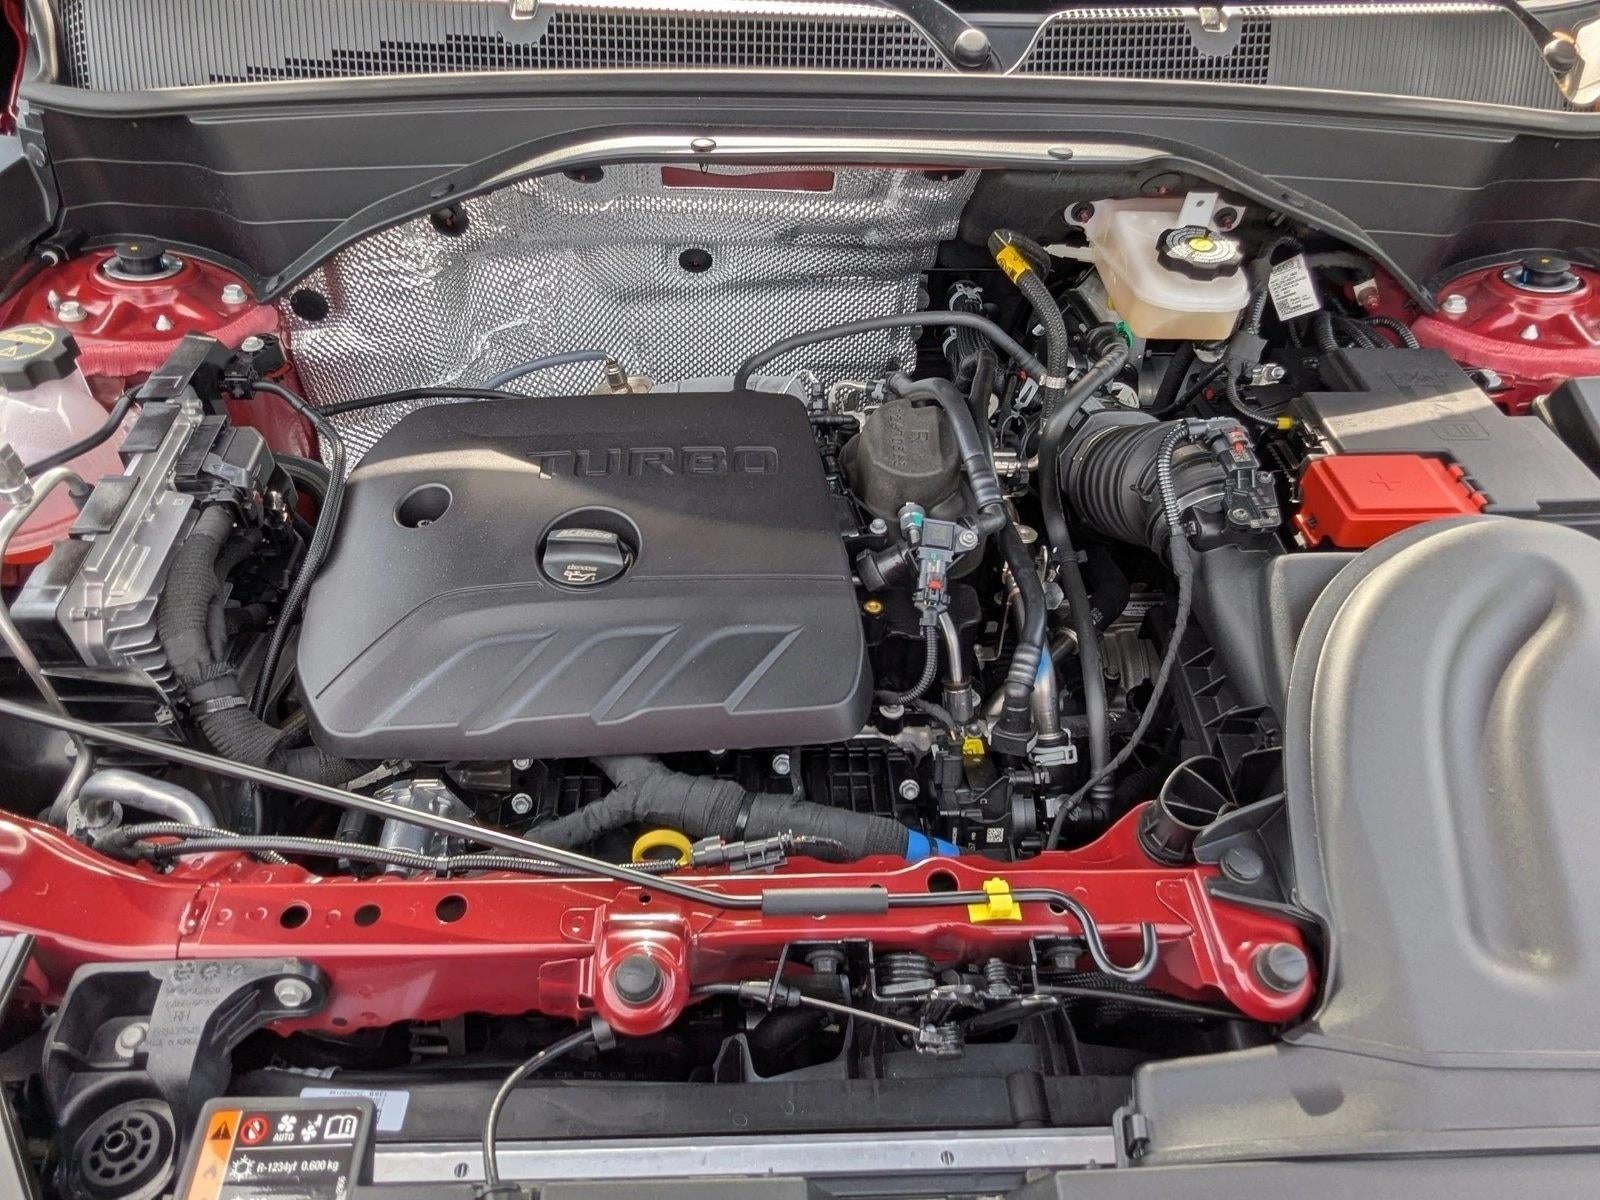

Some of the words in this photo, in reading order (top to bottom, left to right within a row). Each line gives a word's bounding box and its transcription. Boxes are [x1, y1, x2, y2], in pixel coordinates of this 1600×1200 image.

[527, 446, 779, 478] TURBO
[273, 1132, 295, 1142] AUTO
[256, 1160, 298, 1176] R-1234yf
[301, 1160, 326, 1171] 0.600
[327, 1160, 340, 1172] kg
